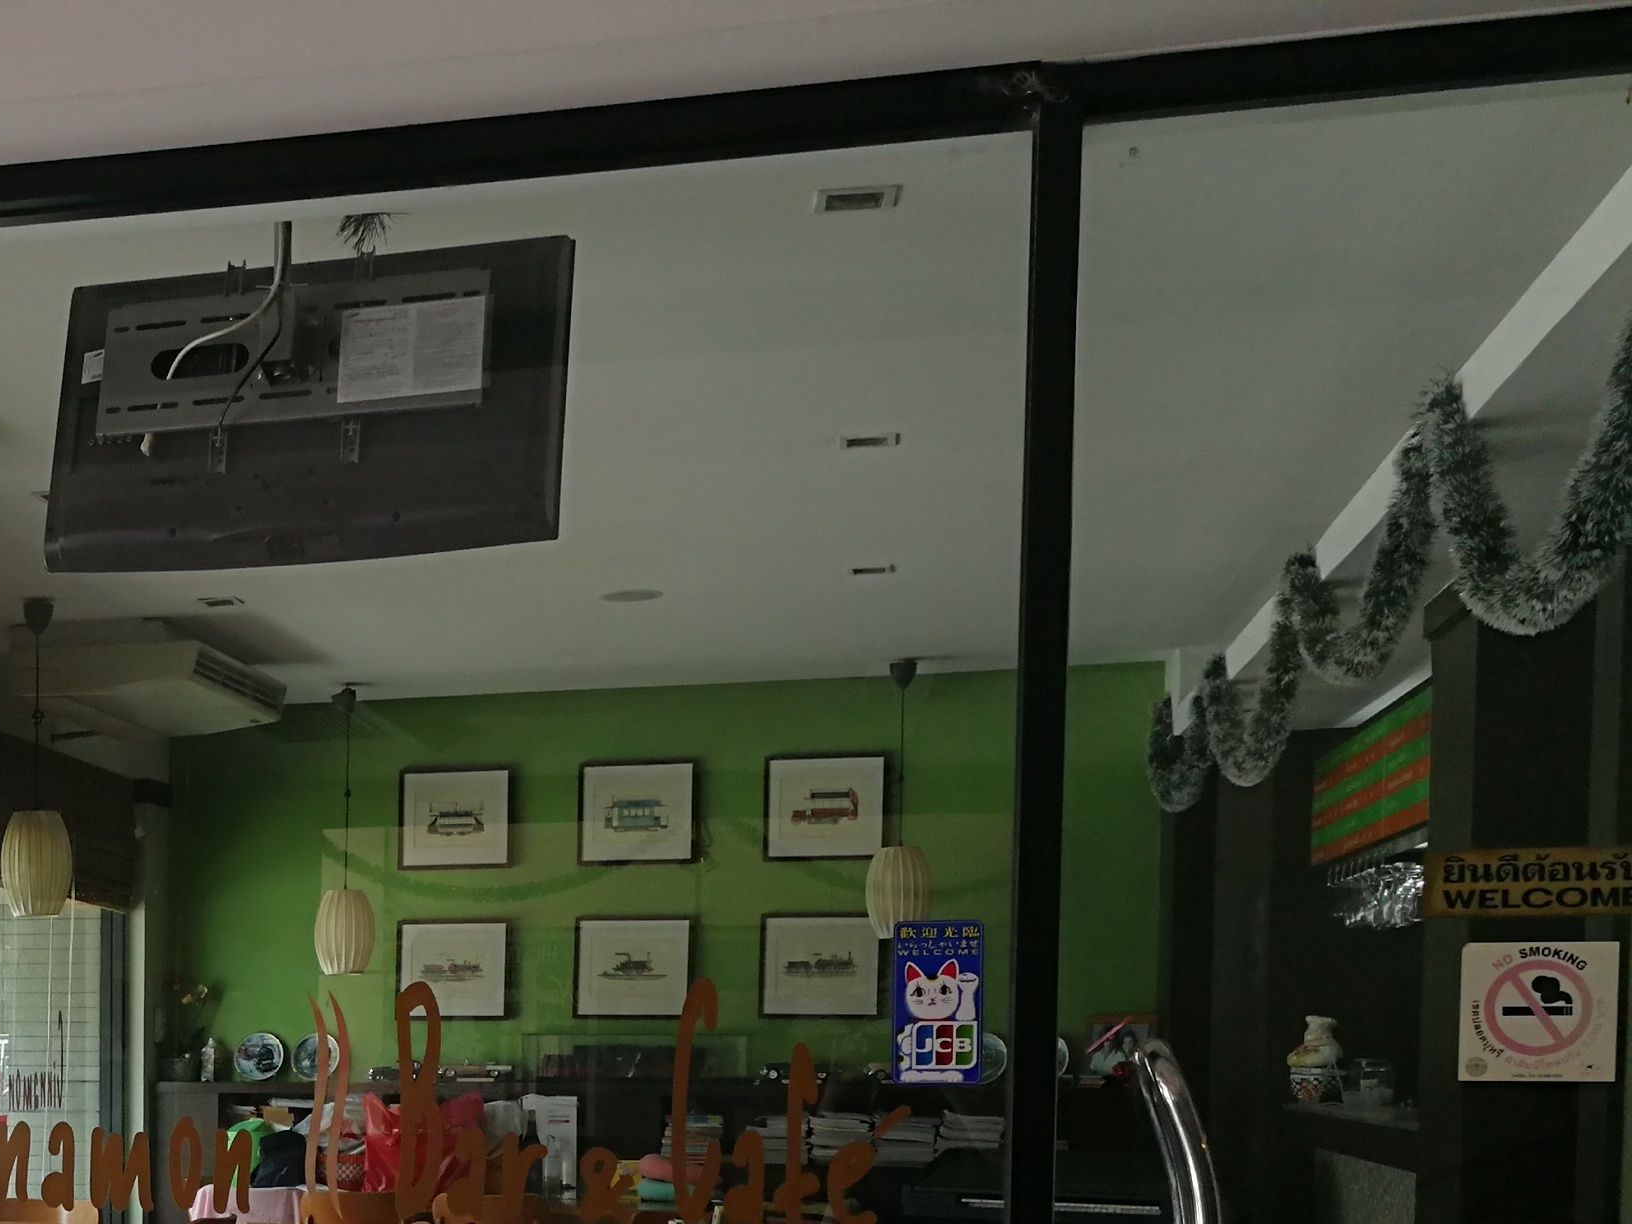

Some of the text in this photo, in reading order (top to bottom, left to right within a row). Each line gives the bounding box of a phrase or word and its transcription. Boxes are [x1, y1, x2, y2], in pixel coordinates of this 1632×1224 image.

[1442, 886, 1632, 910] WELCOME
[1491, 945, 1588, 972] NO SMOKING
[915, 1037, 972, 1053] JCB
[395, 980, 549, 1218] Bar
[574, 1146, 641, 1223] &
